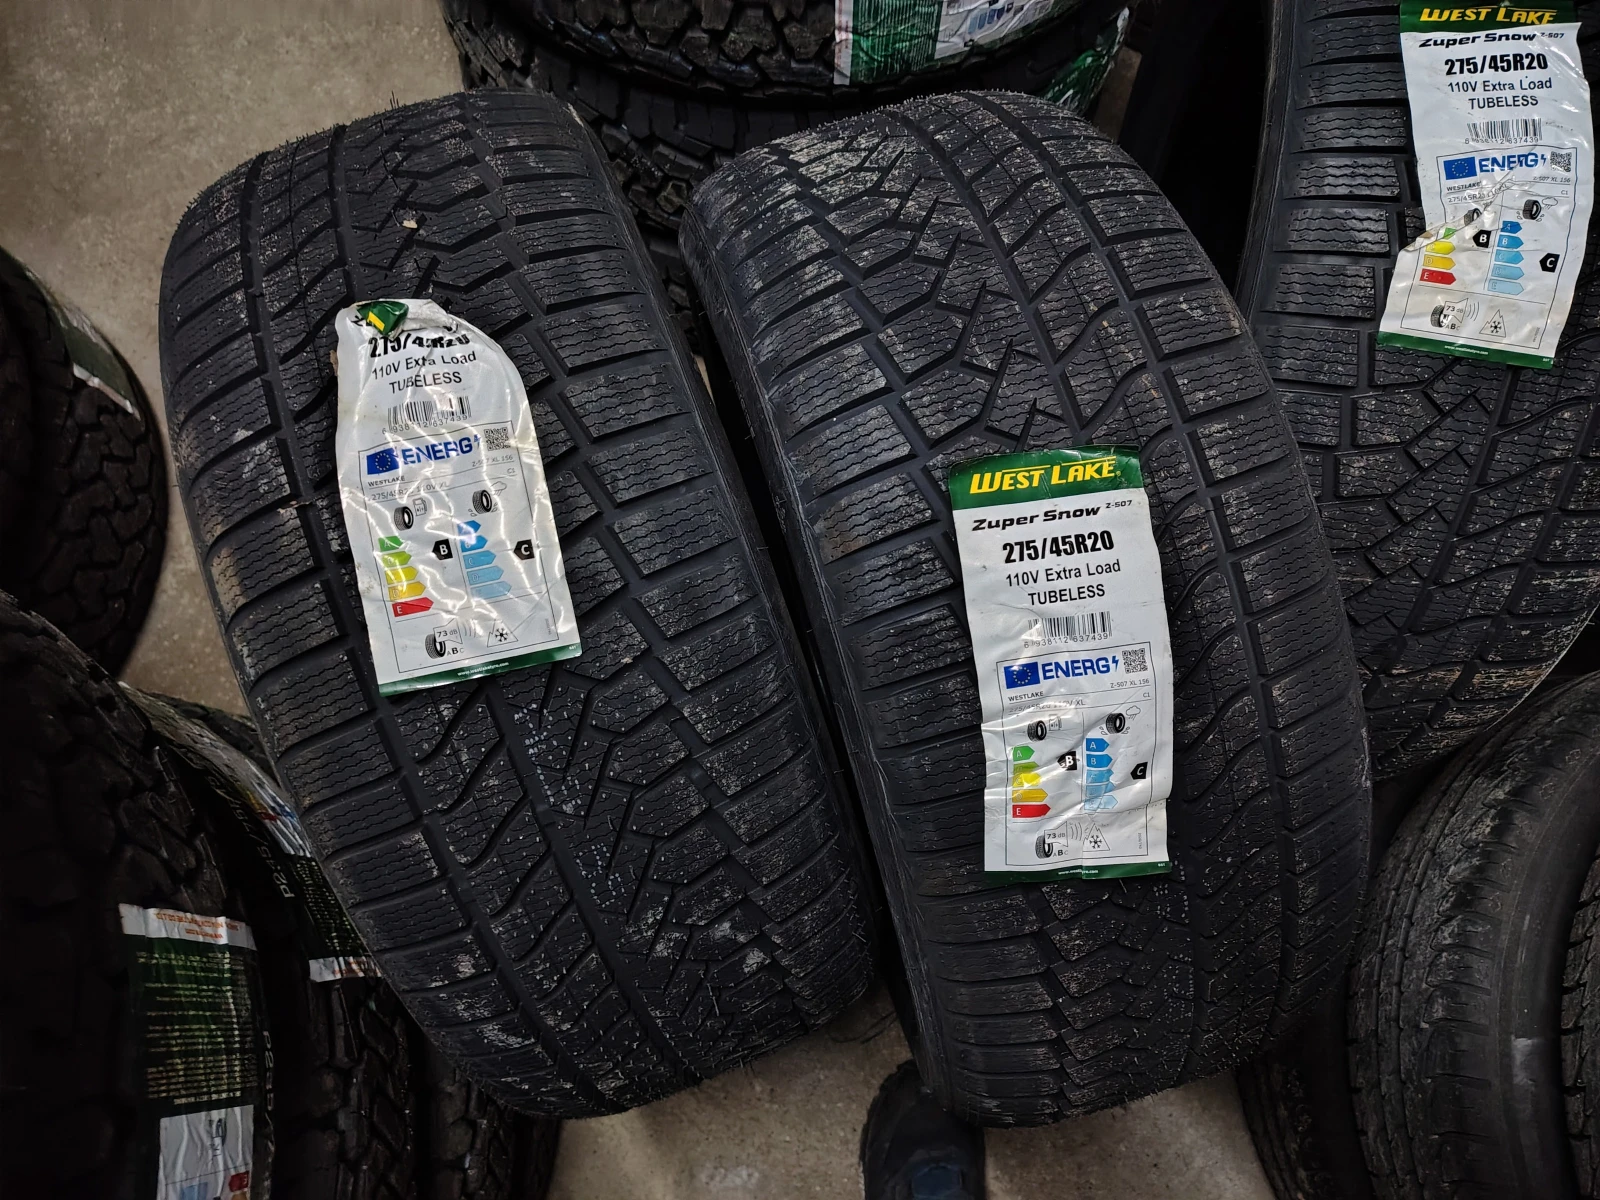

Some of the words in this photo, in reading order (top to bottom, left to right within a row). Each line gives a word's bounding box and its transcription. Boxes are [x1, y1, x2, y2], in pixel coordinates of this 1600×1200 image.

[1420, 6, 1497, 22] WEST
[1419, 35, 1481, 48] Zuper
[1483, 32, 1536, 42] Snow
[1444, 52, 1548, 76] 275/45R20
[1448, 81, 1477, 93] 110V
[1483, 80, 1515, 92] Extra
[1520, 77, 1553, 90] Load
[1468, 95, 1539, 110] TUBELESS
[1479, 233, 1487, 242] B
[1545, 257, 1555, 268] C
[1423, 272, 1430, 280] E
[372, 361, 401, 380] 110V
[441, 351, 477, 365] Load
[389, 371, 462, 394] TUBELESS
[402, 437, 473, 465] ENERG
[507, 467, 516, 475] C1
[970, 465, 1050, 494] WEST
[1051, 456, 1117, 485] LAKE
[368, 475, 406, 487] WESTLAKE
[416, 482, 437, 493] 10V
[972, 513, 1040, 531] Zuper
[1043, 506, 1102, 522] Snow
[1105, 500, 1132, 509] Z-507
[439, 544, 449, 556] B
[520, 543, 530, 555] C
[1003, 530, 1115, 564] 275/45R20
[1006, 570, 1040, 587] 110V
[1045, 567, 1082, 582] Extra
[1087, 559, 1121, 575] Load
[1028, 584, 1106, 606] TUBELESS
[397, 605, 403, 614] E
[1073, 633, 1109, 643] 637439
[1041, 657, 1110, 681] ENERG
[1110, 680, 1128, 688] Z-507
[1008, 690, 1044, 702] WESTLAKE
[1075, 698, 1086, 706] XL
[1089, 741, 1096, 749] A
[1016, 749, 1023, 758] A
[1065, 755, 1074, 766] B
[1090, 757, 1096, 765] B
[1136, 766, 1144, 776] C
[1016, 807, 1022, 816] E
